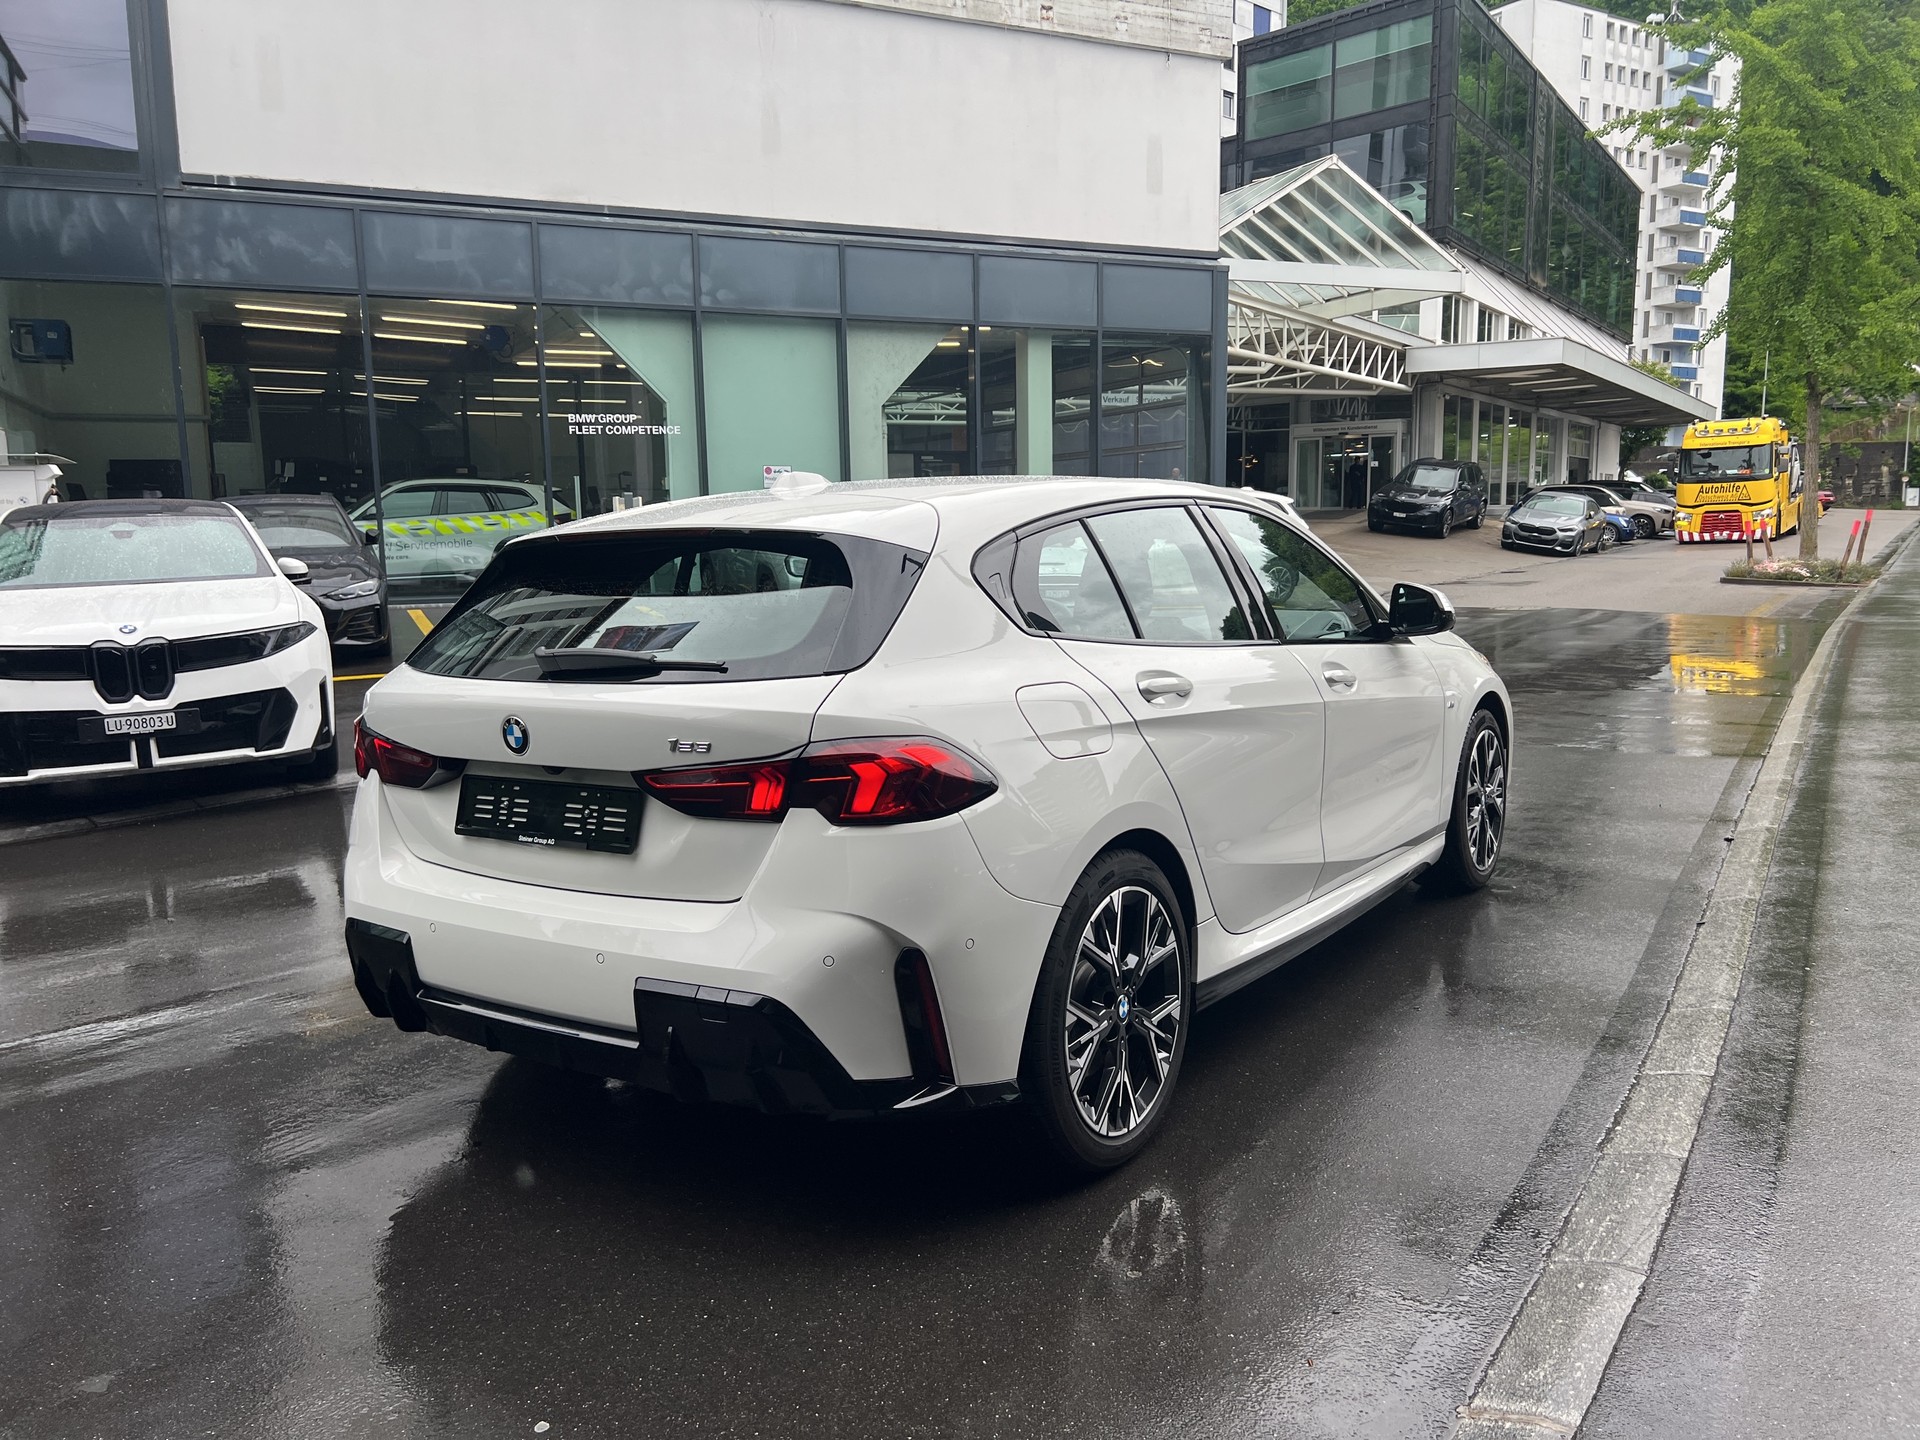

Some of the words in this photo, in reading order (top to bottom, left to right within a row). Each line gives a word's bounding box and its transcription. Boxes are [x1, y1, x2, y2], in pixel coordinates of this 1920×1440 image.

[1103, 395, 1130, 404] Verkauf
[568, 414, 595, 423] BMW
[598, 414, 637, 423] GROUP
[569, 426, 603, 435] FLEET
[605, 426, 681, 435] COMPETENCE
[1699, 483, 1741, 494] Autohilfe
[395, 538, 473, 552] Servicemobile
[518, 834, 534, 842] Steiner
[533, 836, 547, 845] Group
